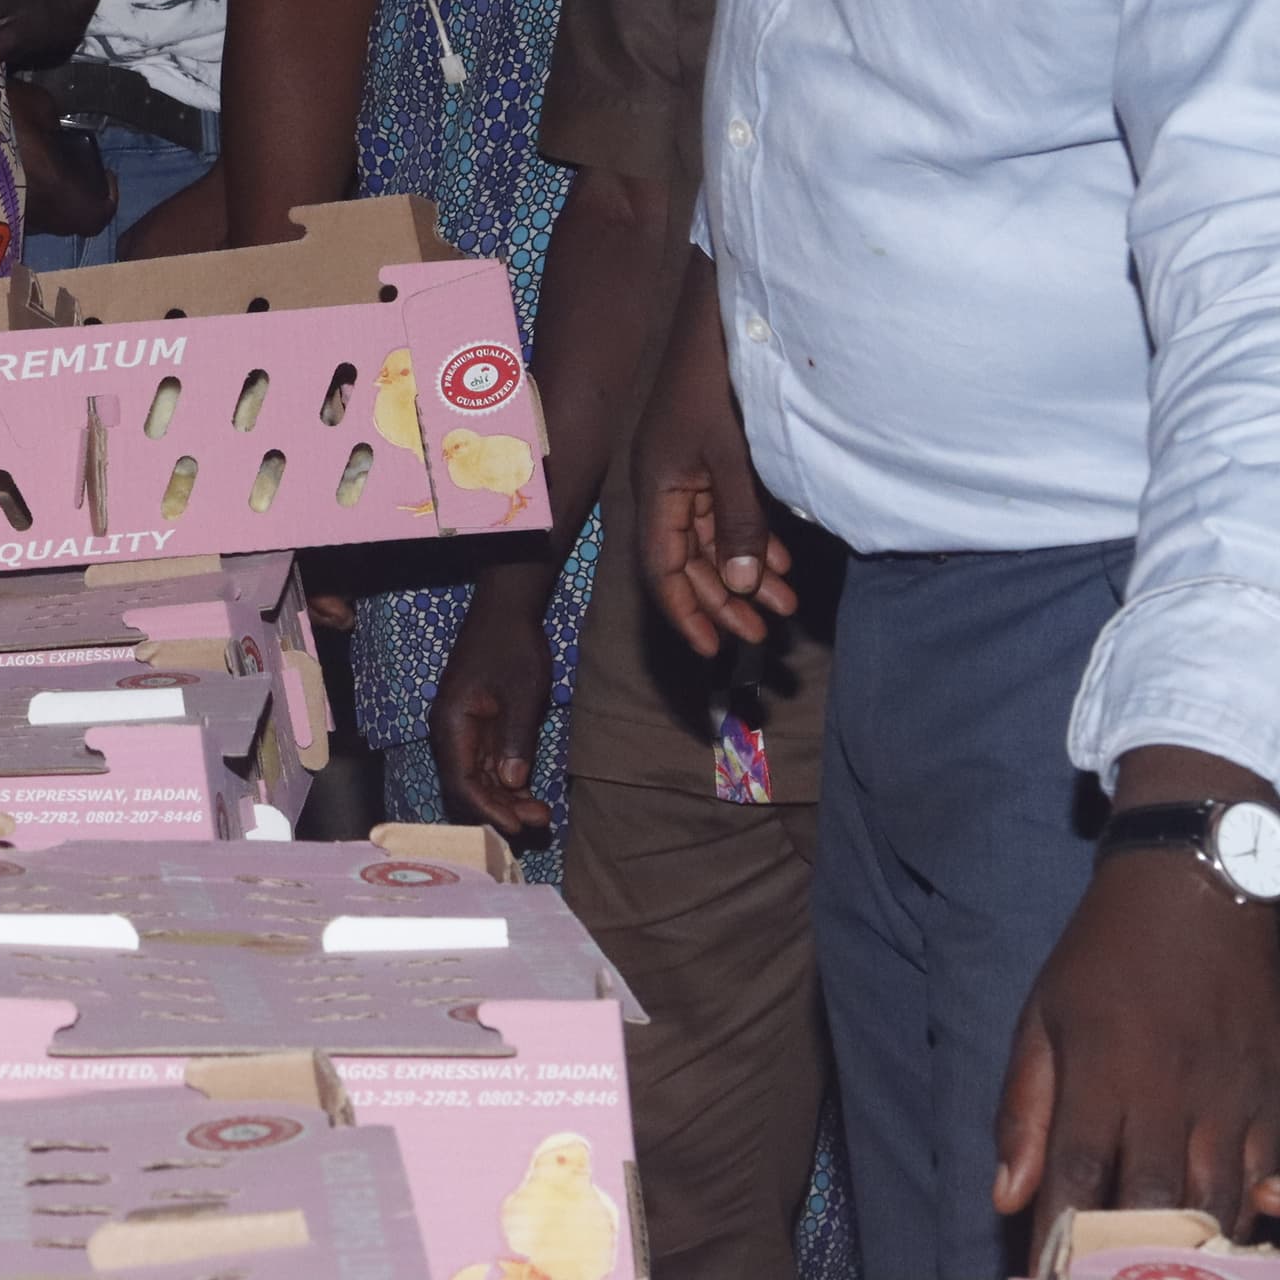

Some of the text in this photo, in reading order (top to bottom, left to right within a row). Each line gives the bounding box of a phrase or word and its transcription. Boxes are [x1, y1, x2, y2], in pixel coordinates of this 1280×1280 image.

[444, 349, 515, 387] PREMIUM QUALITY
[456, 379, 514, 407] GUARANTEED
[49, 649, 136, 664] EXPRESSWA
[15, 788, 128, 803] EXPRESSWAY,
[134, 788, 203, 803] IBADAN,
[86, 810, 203, 825] 0802-207-8446
[69, 1063, 159, 1081] LIMITED,
[394, 1063, 529, 1081] EXPRESSWAY,
[535, 1064, 618, 1082] IBADAN,
[478, 1090, 618, 1107] 0802-207-8446
